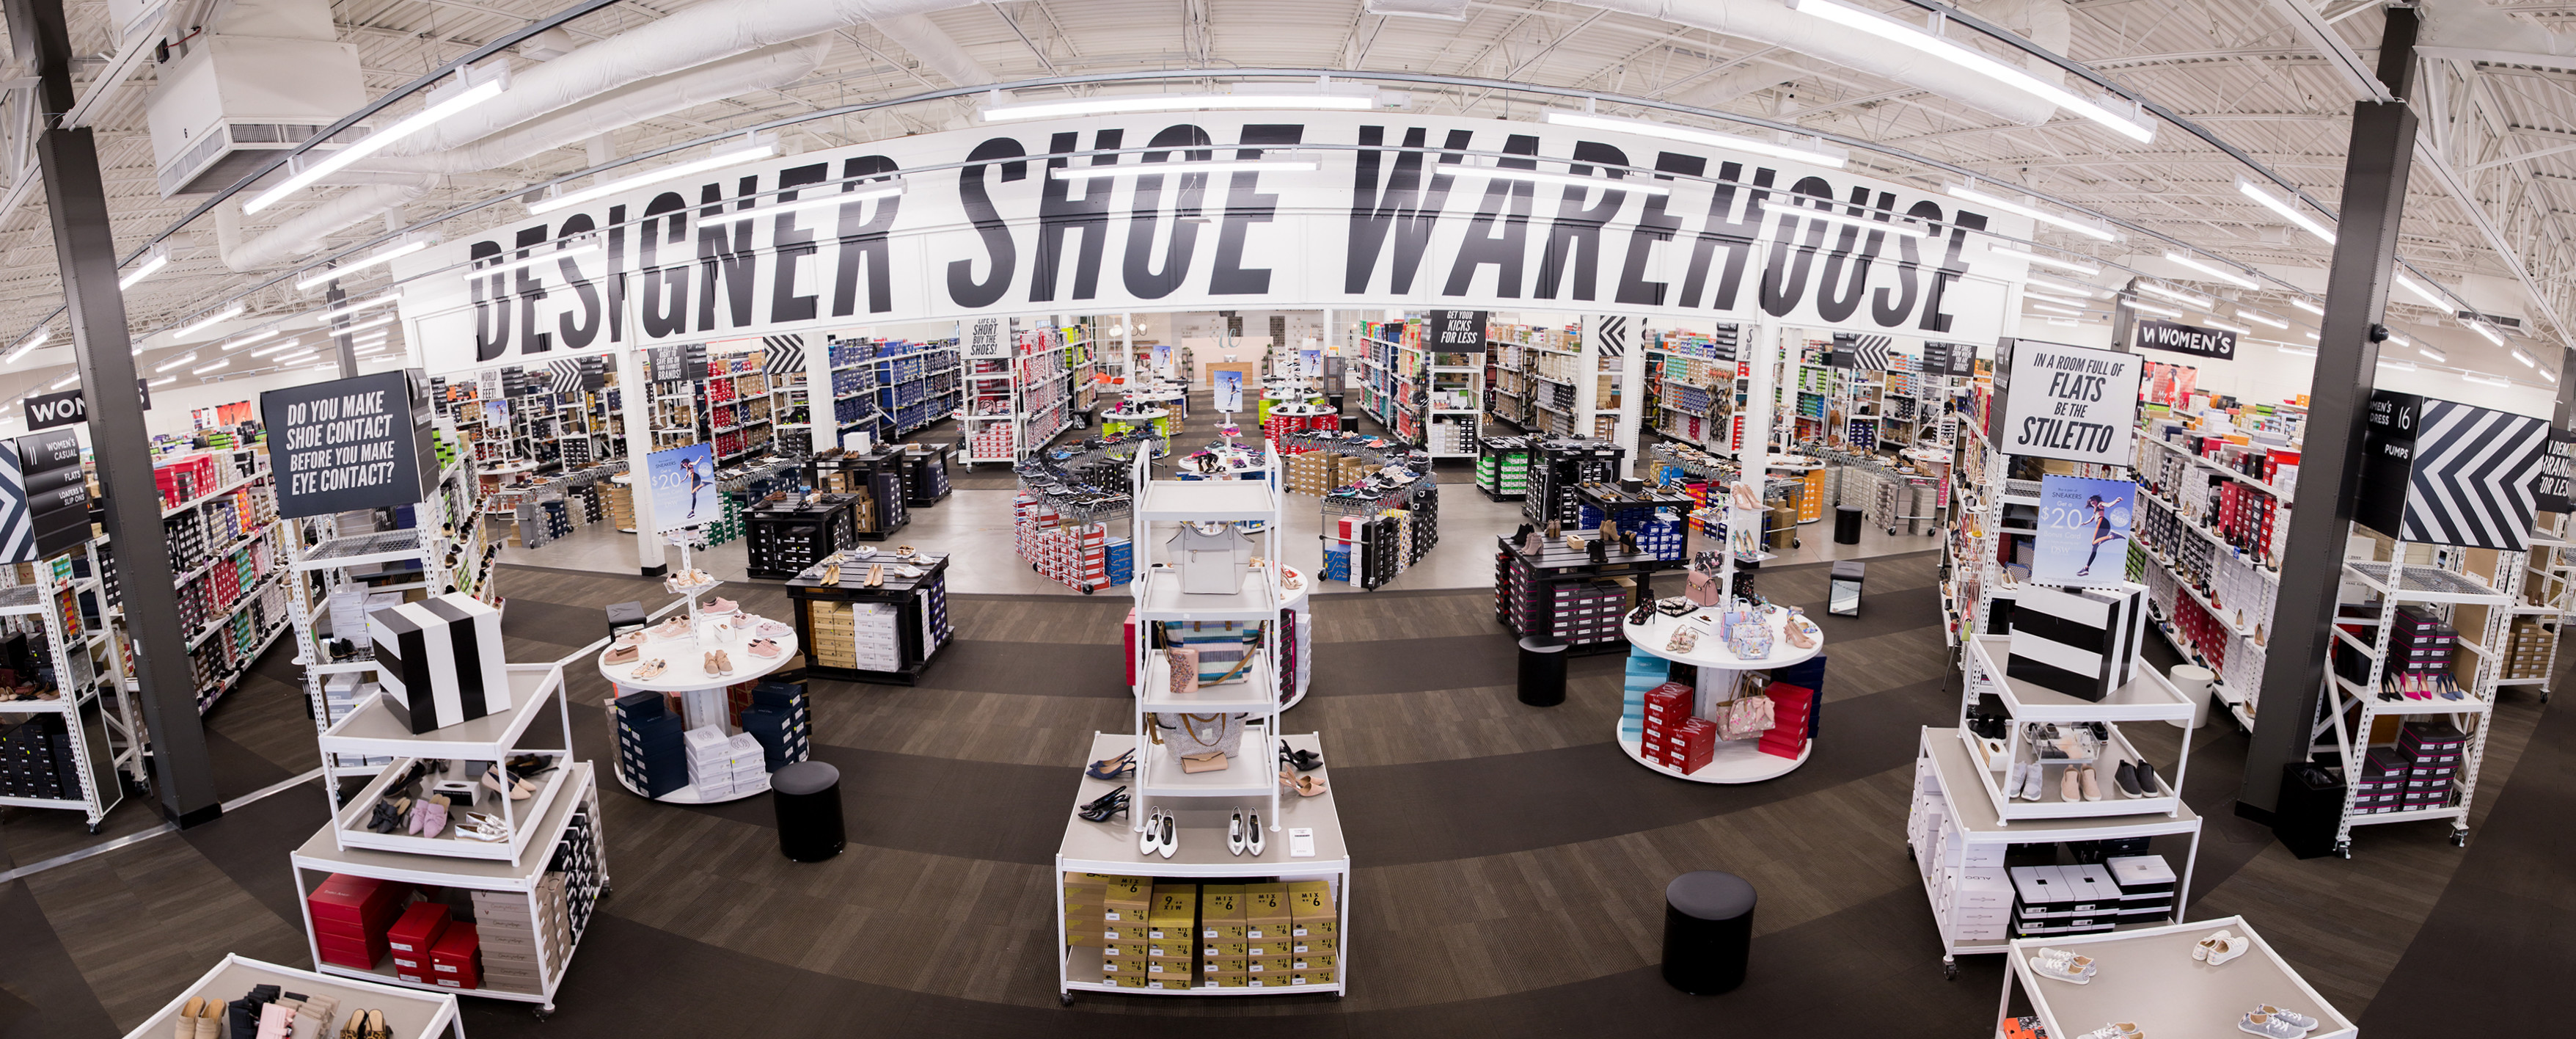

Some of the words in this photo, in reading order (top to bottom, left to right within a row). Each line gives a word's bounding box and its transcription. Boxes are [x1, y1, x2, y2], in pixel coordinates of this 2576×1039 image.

[470, 155, 901, 362] DESIGNER
[947, 124, 1304, 308] SHOE
[1345, 125, 1987, 333] WAREHOUSE
[1446, 310, 1457, 319] GET
[1459, 310, 1474, 320] YOUR
[1446, 320, 1472, 332] KICKS
[973, 335, 984, 345] BUY
[986, 334, 998, 343] THE
[1441, 331, 1455, 343] FOR
[1457, 332, 1477, 344] LESS
[2159, 327, 2231, 354] WOMEN'S
[970, 343, 997, 356] SHOES!
[656, 357, 666, 365] SAVE
[2033, 352, 2046, 367] IN
[2046, 354, 2055, 368] A
[2056, 356, 2086, 372] ROOM
[2087, 359, 2109, 374] FULL
[2111, 362, 2124, 377] OF
[480, 371, 497, 382] WORLD
[658, 368, 681, 380] BRANDS!
[483, 387, 497, 399] FEET!
[2048, 371, 2106, 402] FLATS
[288, 403, 307, 426] DO
[310, 397, 338, 423] YOU
[343, 390, 385, 418] MAKE
[2054, 402, 2068, 416] BE
[2070, 404, 2088, 418] THE
[2369, 400, 2392, 413] MEN'S
[2398, 406, 2410, 430] 16
[2369, 412, 2390, 426] DRESS
[286, 424, 323, 451] SHOE
[326, 414, 393, 445] CONTACT
[2018, 416, 2115, 453] STILETTO
[46, 437, 76, 452] WOMEN'S
[2385, 443, 2409, 459] PUMPS
[54, 448, 77, 461] CASUAL
[290, 449, 332, 472] BEFORE
[335, 445, 358, 466] YOU
[361, 440, 395, 462] MAKE
[655, 461, 676, 469] SNEAKERS
[65, 470, 81, 481] FLATS
[292, 471, 318, 495] EYE
[321, 461, 395, 492] CONTACT?
[651, 472, 681, 491] $20
[2539, 475, 2554, 495] OR
[2553, 478, 2569, 497] LES
[59, 487, 79, 499] LOAFERS
[2052, 492, 2082, 500] SNEAKERS
[65, 497, 74, 506] SLIP
[74, 494, 85, 503] ONS
[2041, 506, 2082, 530] $20
[1130, 884, 1137, 892] 6
[1226, 901, 1232, 910] 6
[1269, 899, 1276, 907] 6
[1313, 897, 1320, 906] 6
